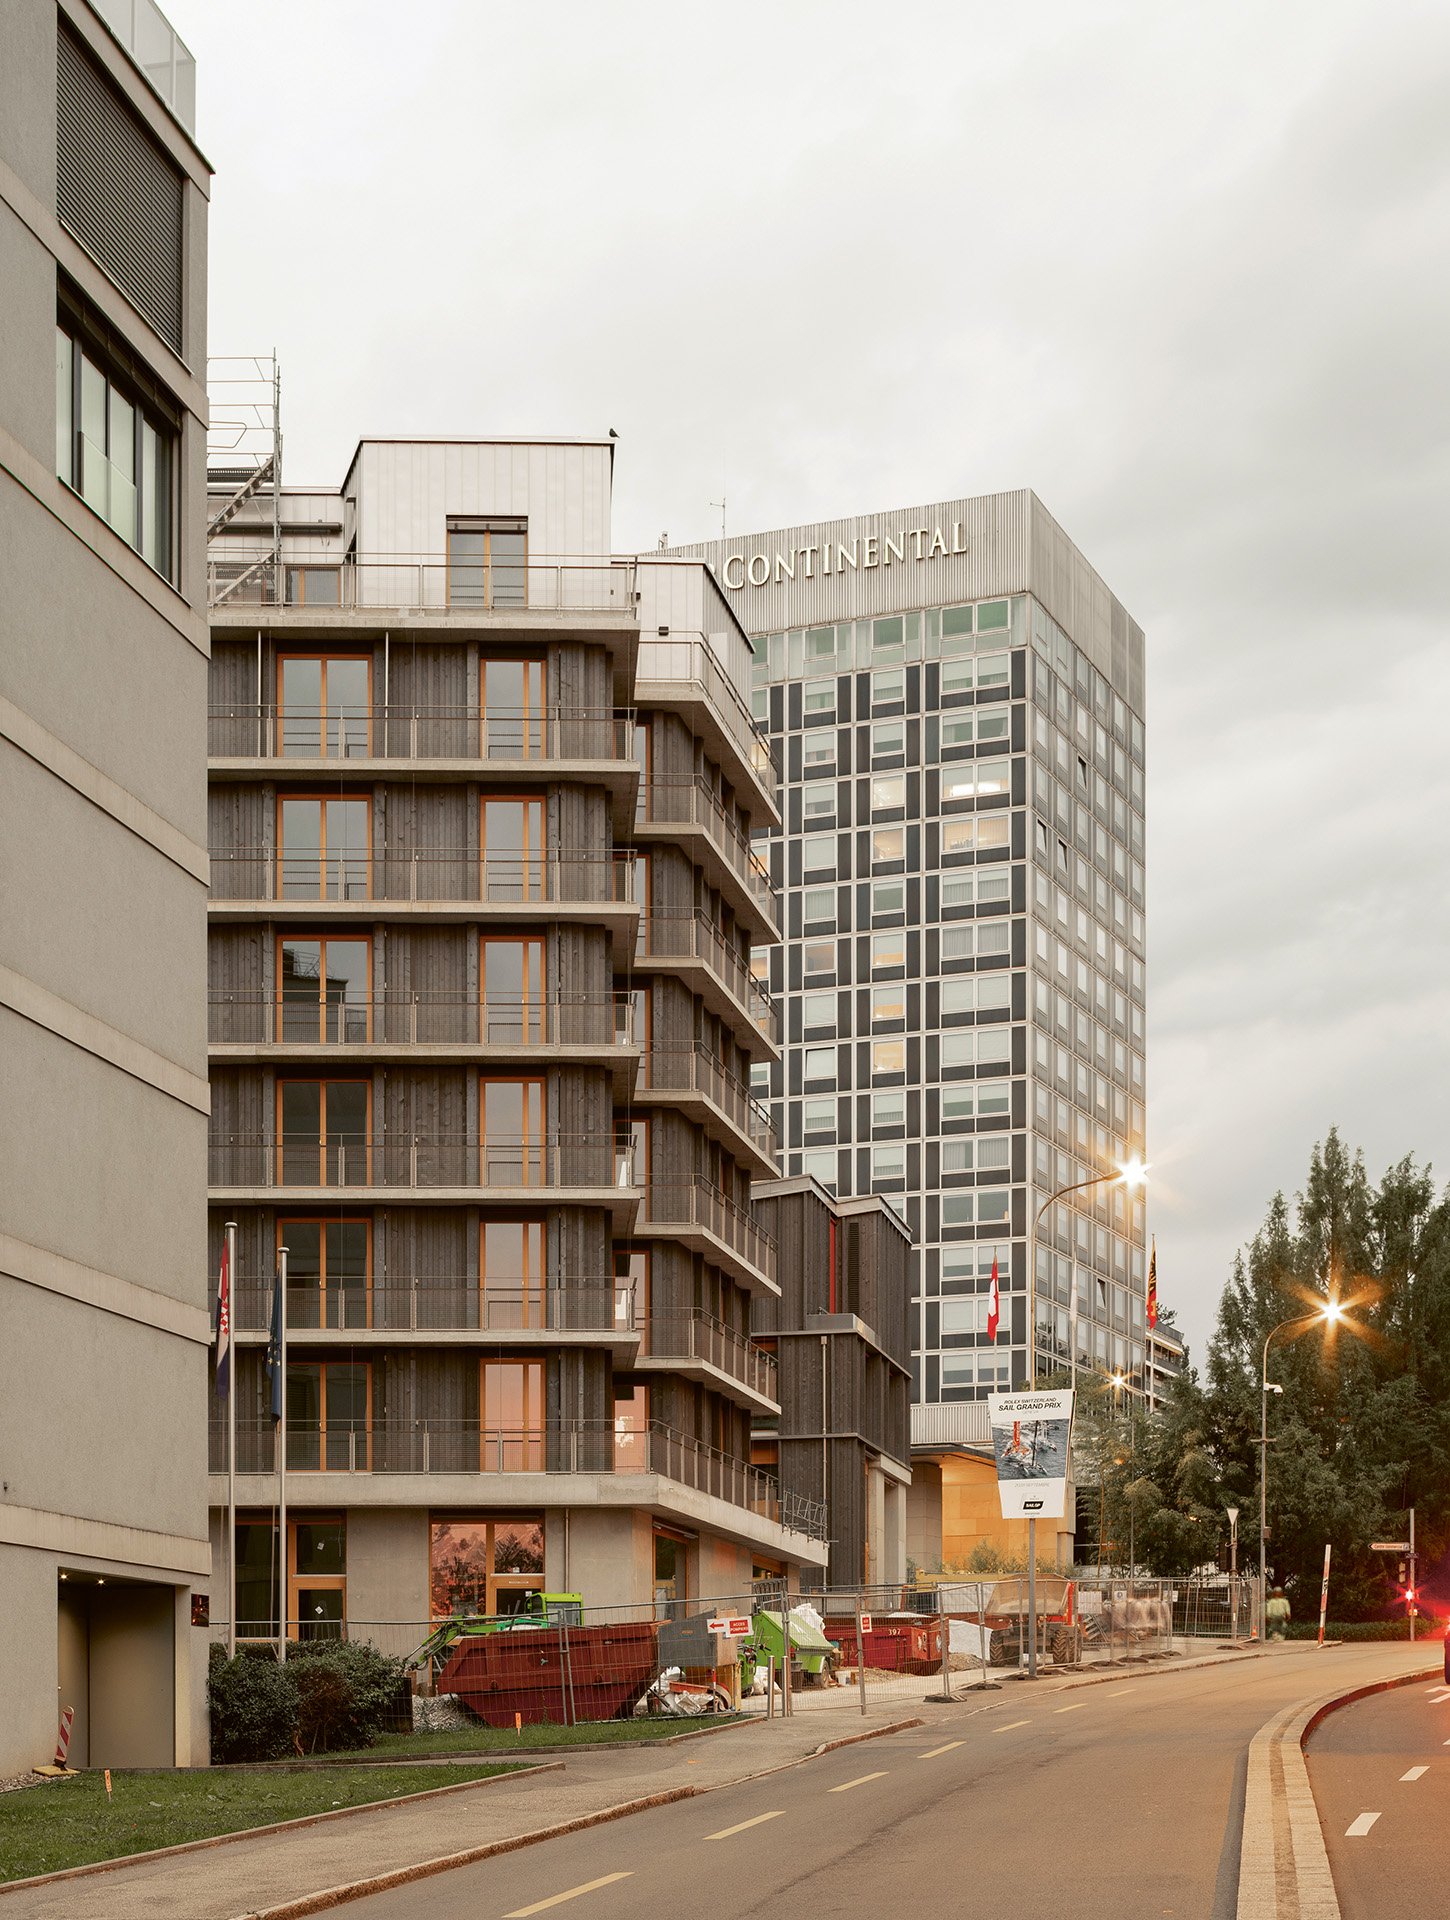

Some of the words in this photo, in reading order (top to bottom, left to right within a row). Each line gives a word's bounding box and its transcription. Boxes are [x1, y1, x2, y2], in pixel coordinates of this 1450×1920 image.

[723, 522, 967, 589] CONTINENTAL
[1016, 1403, 1043, 1411] GRAND
[1044, 1401, 1062, 1409] PRIX
[888, 1628, 901, 1636] 397
